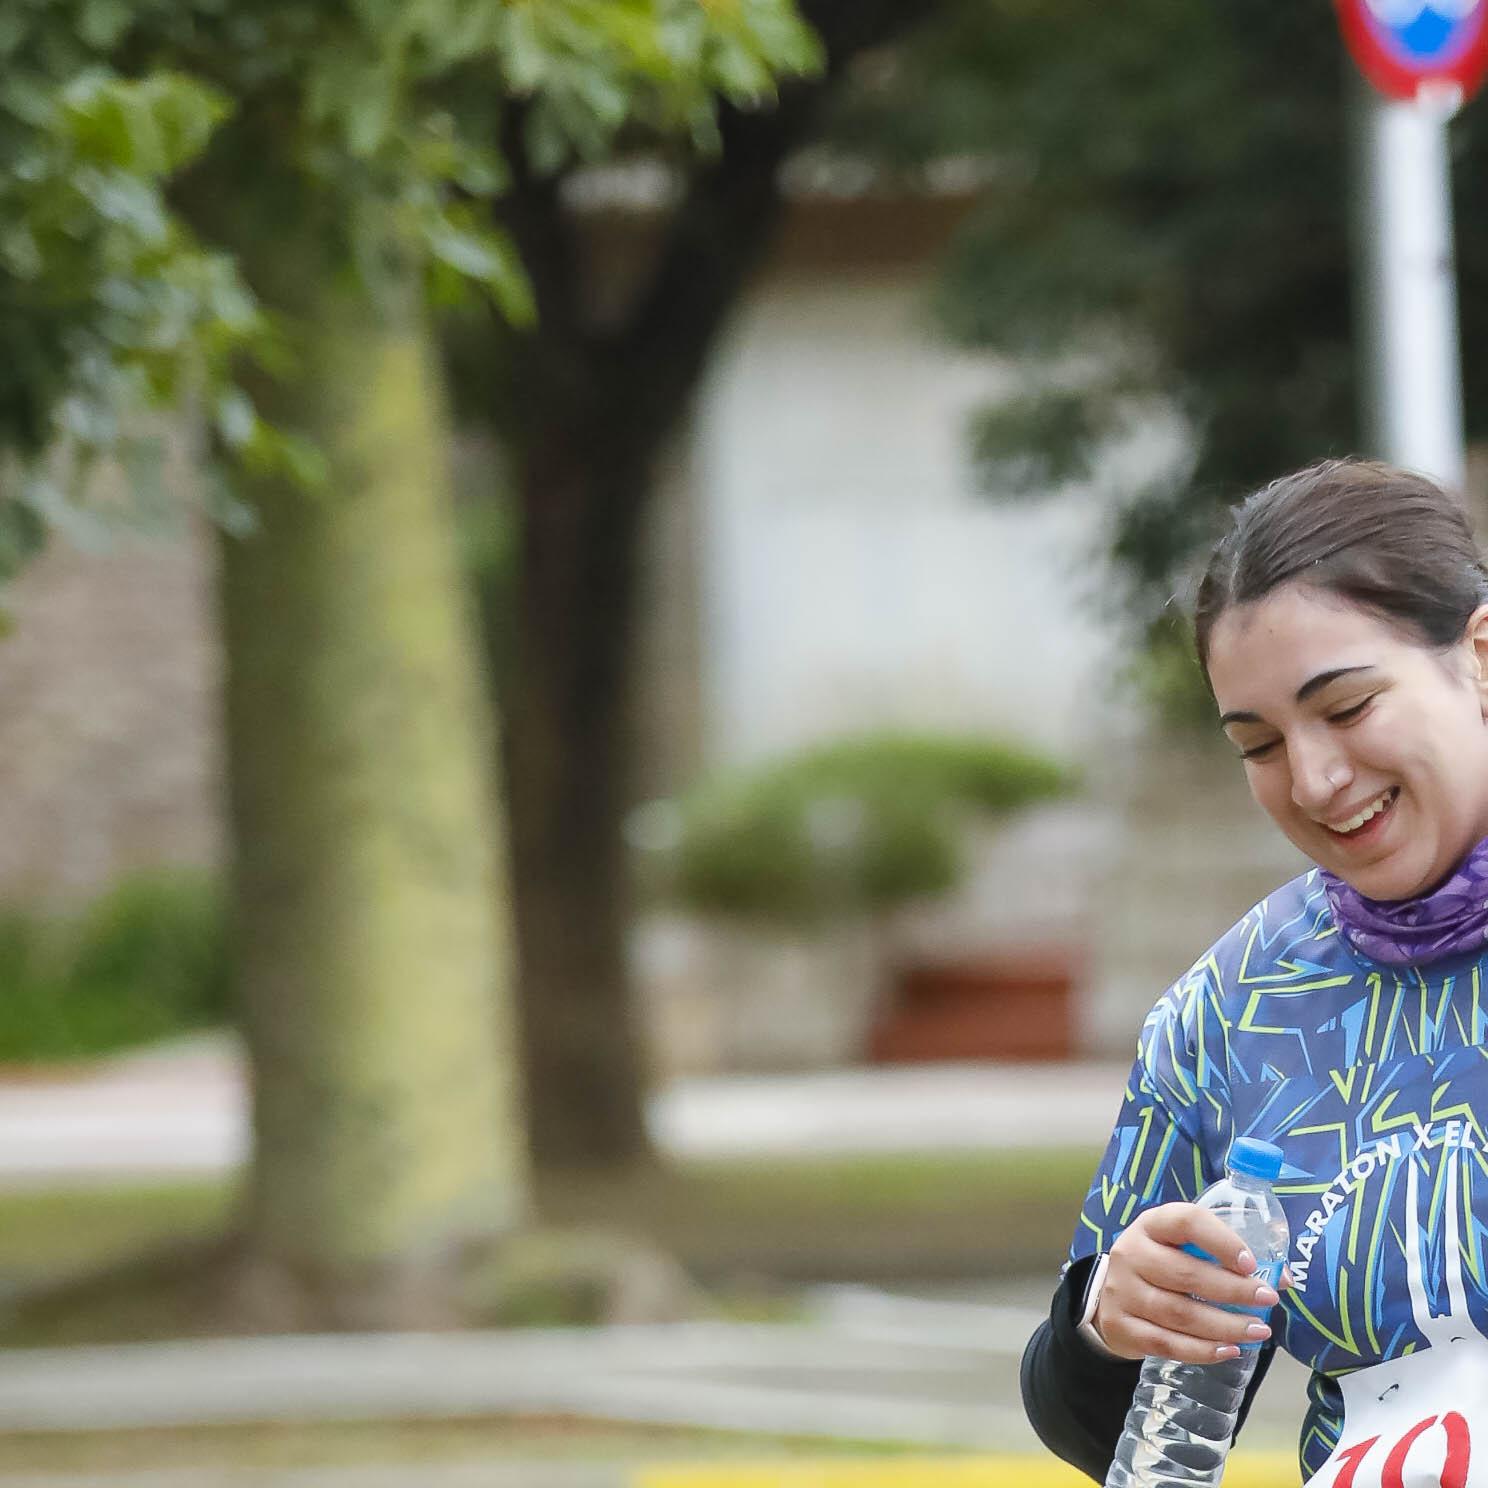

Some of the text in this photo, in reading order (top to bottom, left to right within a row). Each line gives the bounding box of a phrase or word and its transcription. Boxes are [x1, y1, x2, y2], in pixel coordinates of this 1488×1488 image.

[1290, 1133, 1401, 1293] MARATÓN
[1411, 1122, 1434, 1151] X
[1448, 1120, 1475, 1149] EL
